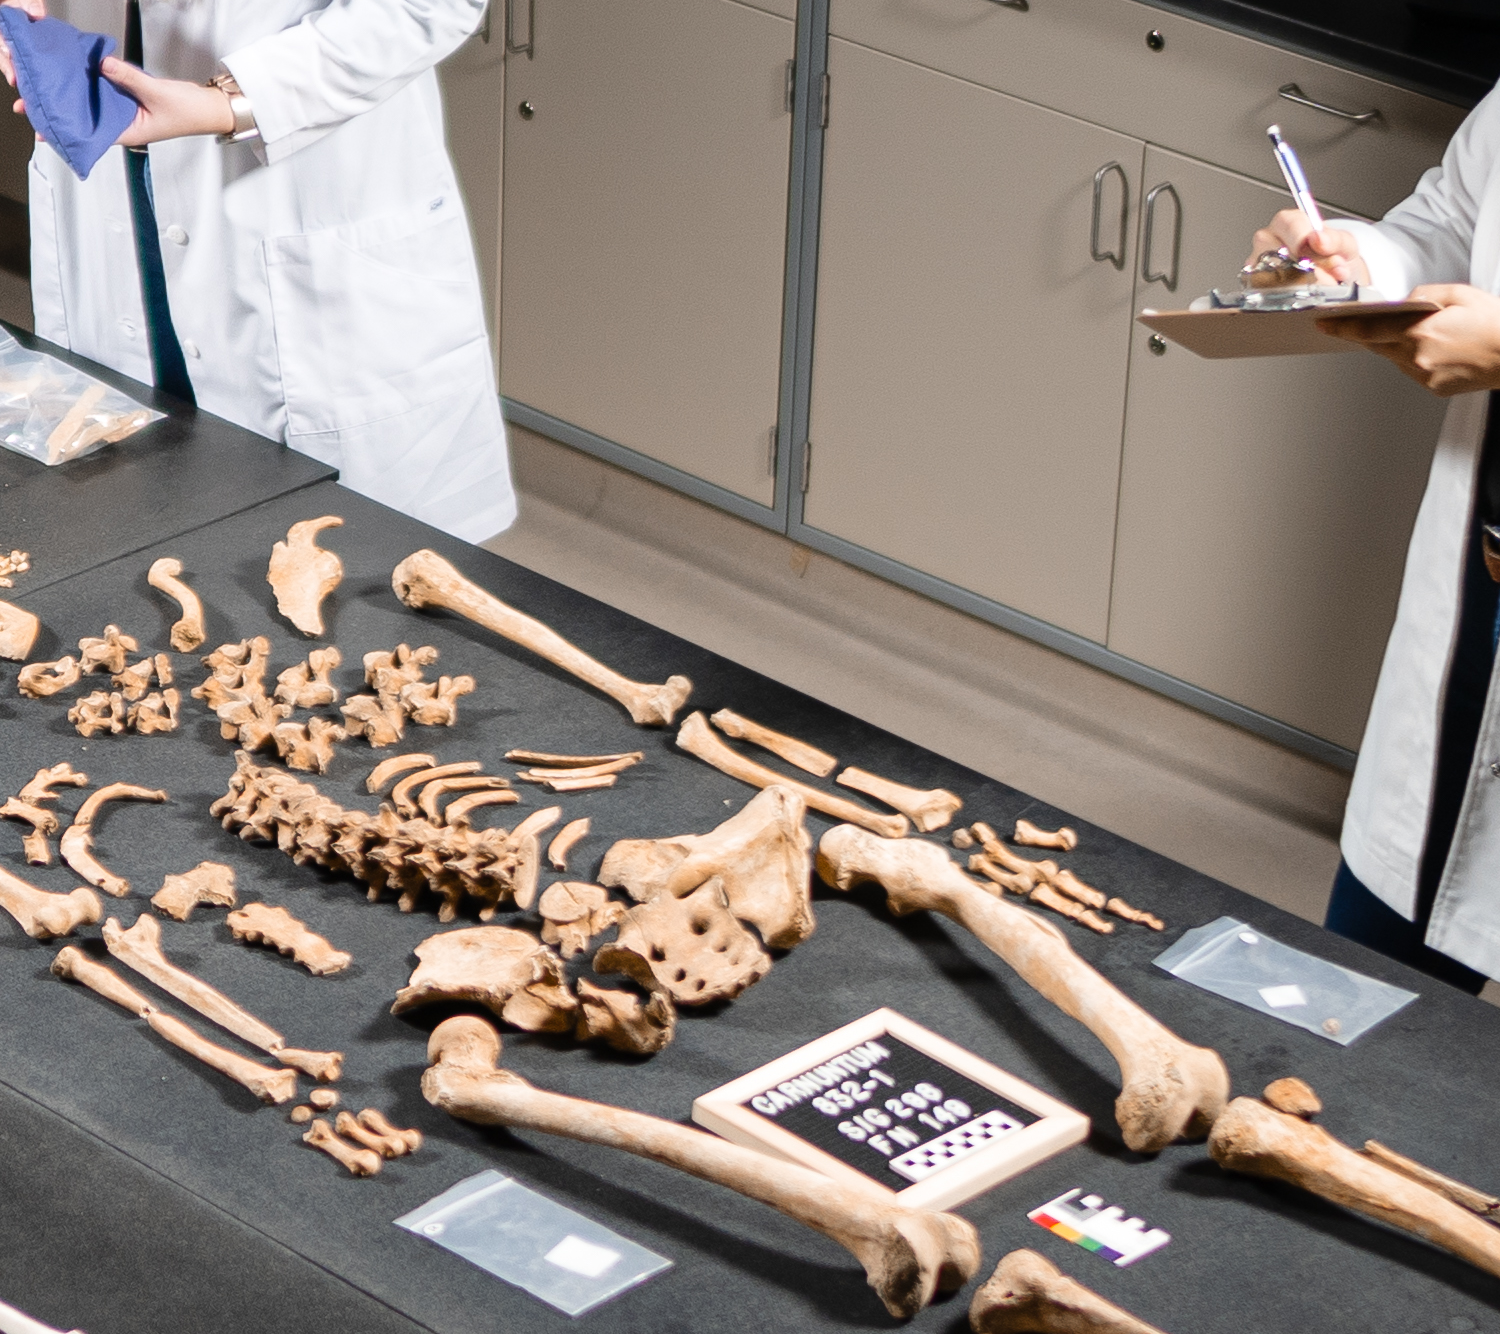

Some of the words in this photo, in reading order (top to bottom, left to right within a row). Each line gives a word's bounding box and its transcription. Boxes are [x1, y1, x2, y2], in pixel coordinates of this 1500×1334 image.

[751, 1040, 892, 1116] CARNUNTUM
[812, 1069, 896, 1116] 832-1
[838, 1108, 892, 1142] SIG
[867, 1125, 920, 1157] FN
